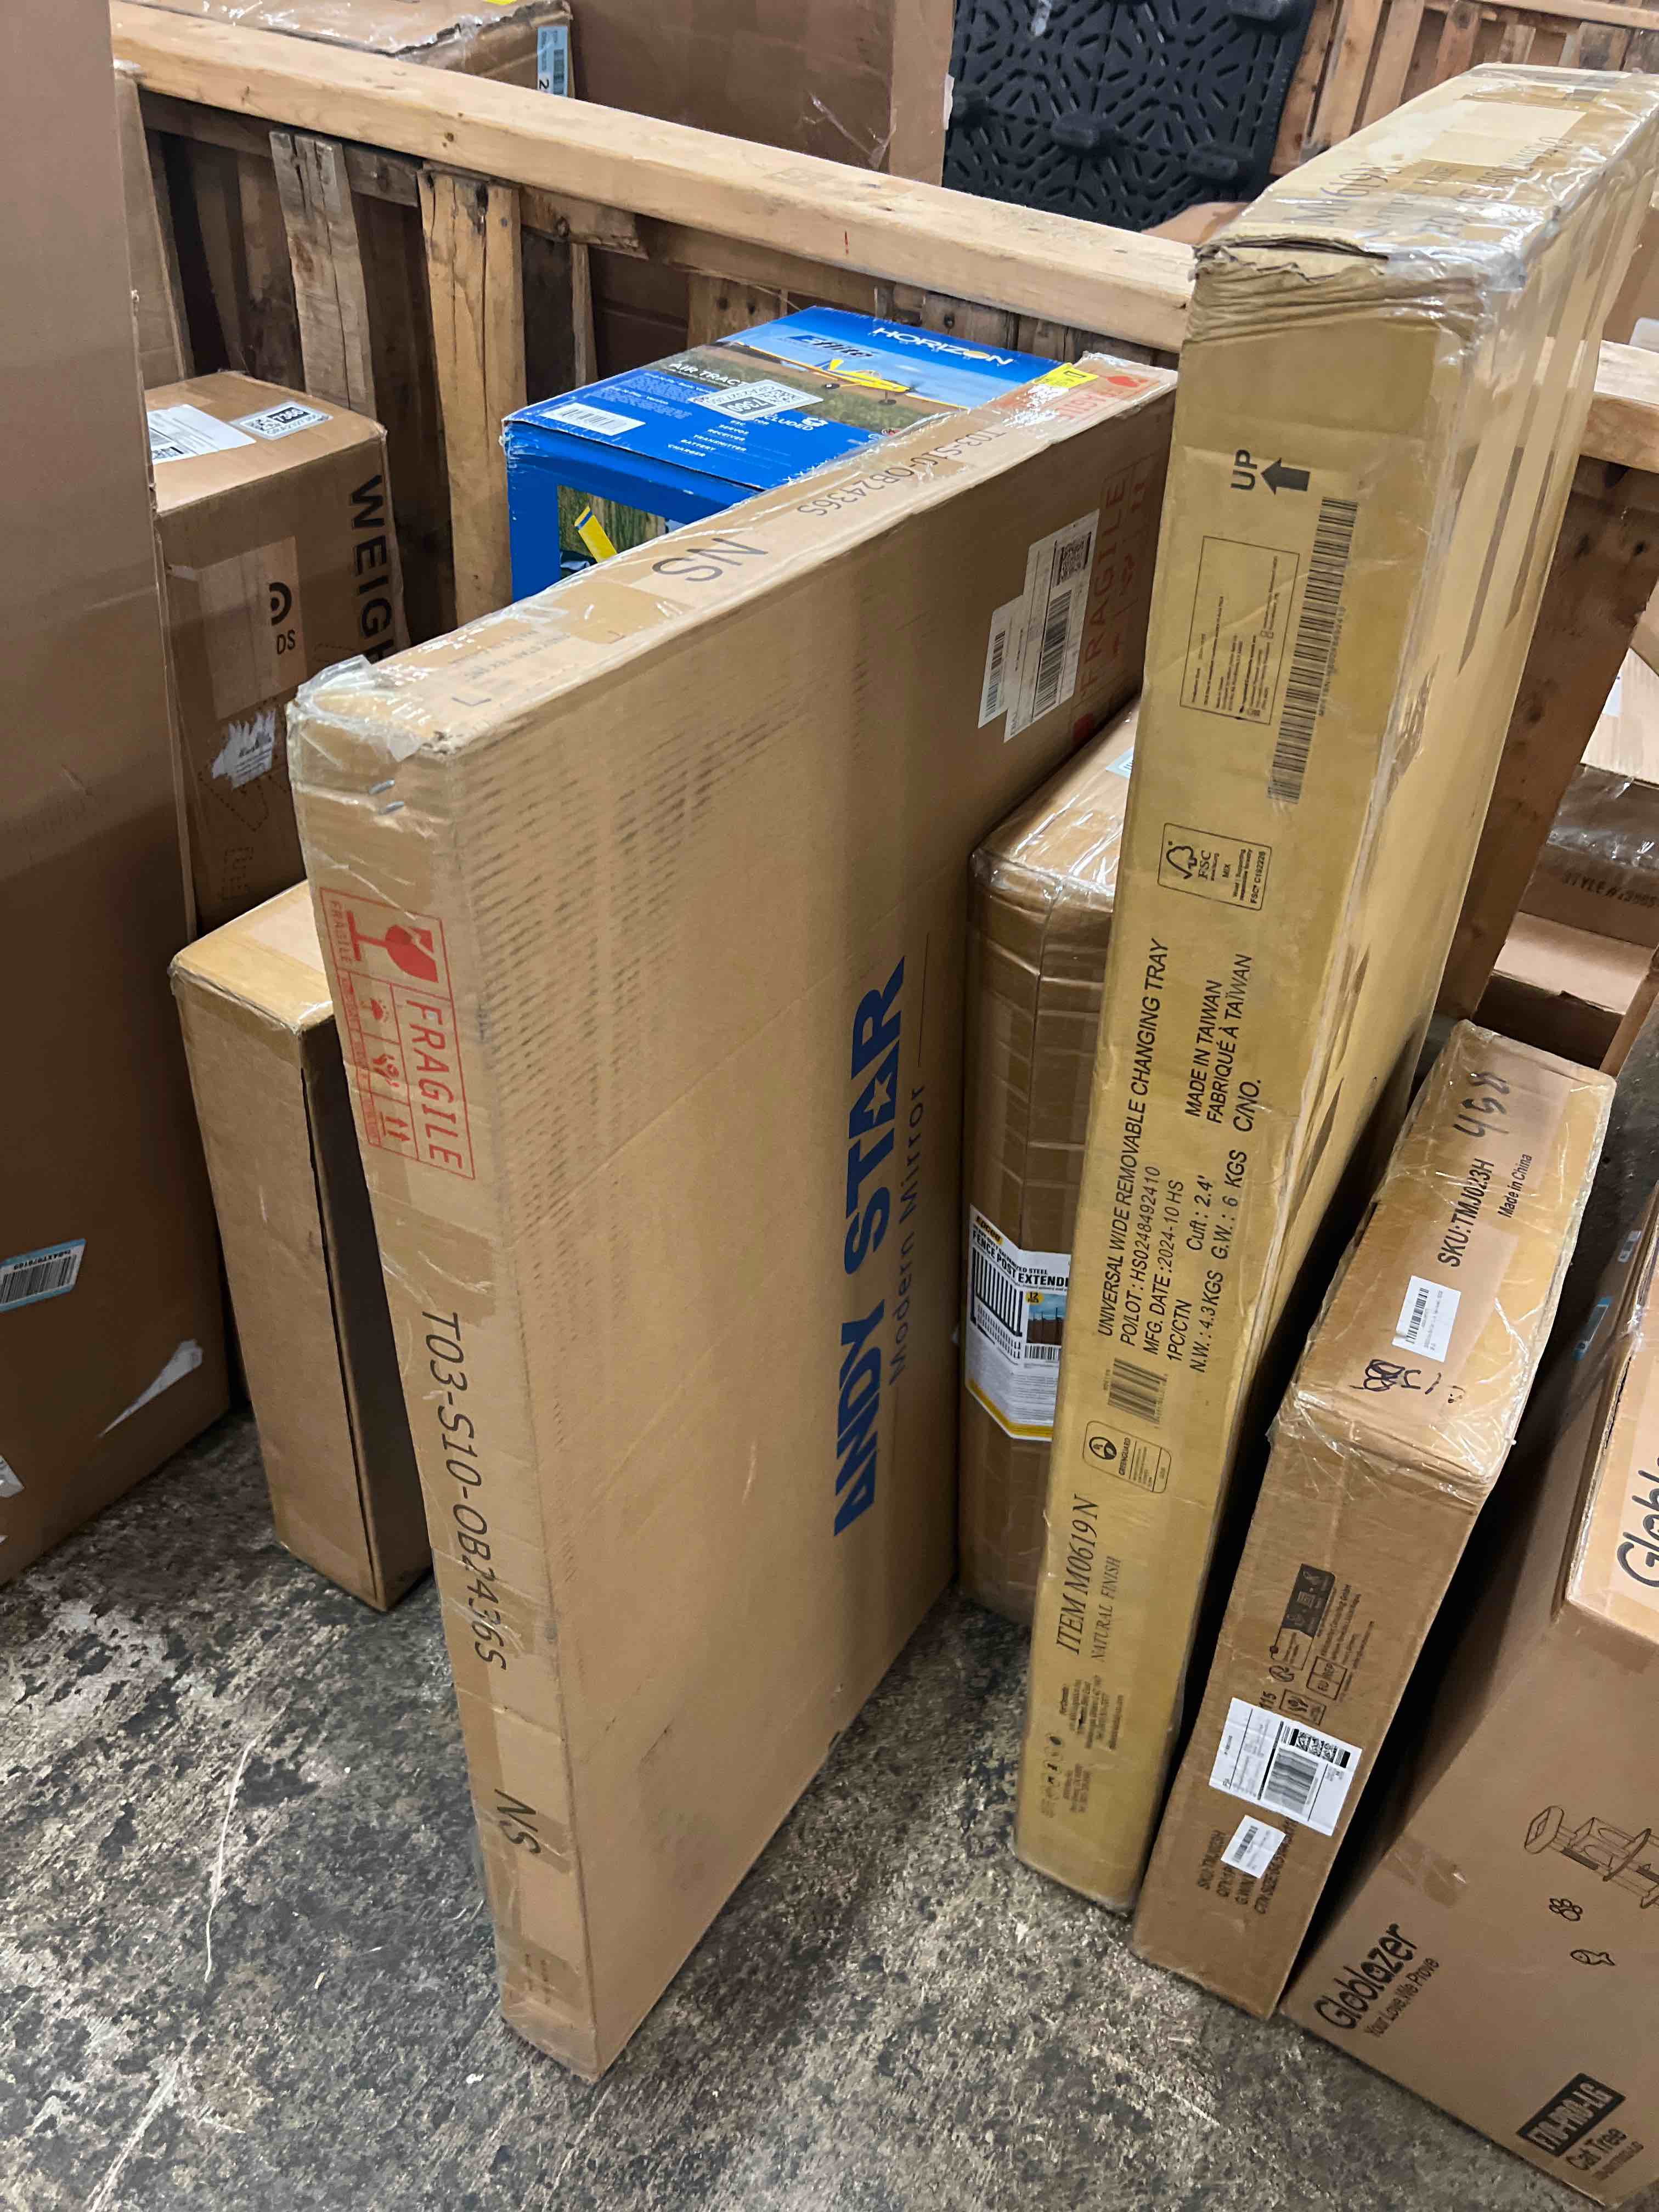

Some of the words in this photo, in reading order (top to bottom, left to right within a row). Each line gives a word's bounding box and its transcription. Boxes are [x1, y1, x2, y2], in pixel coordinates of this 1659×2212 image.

[669, 363, 698, 374] AIR
[870, 326, 1014, 366] HORIZON
[680, 439, 716, 452] BATTERY
[693, 434, 747, 452] TRANSMITTER
[763, 412, 815, 431] CLUDED
[667, 444, 706, 457] CHARGER
[1231, 448, 1259, 492] UP
[1197, 850, 1211, 880] FSC
[1222, 864, 1231, 878] MIX
[330, 900, 351, 962] FRAGILE
[1144, 938, 1168, 990] TRAY
[1195, 980, 1224, 1045] TAIWAN
[1130, 996, 1160, 1096] CHANGING
[1193, 1047, 1210, 1067] IN
[1206, 1040, 1235, 1124] FABRIQUÉ
[1223, 952, 1253, 1020] TAÏWAN
[406, 999, 464, 1169] FRAGILE
[1184, 1069, 1207, 1117] MADE
[1232, 1079, 1262, 1132] C/NO.
[844, 955, 905, 1276] STAR
[900, 1085, 926, 1221] Mirror
[1115, 1098, 1147, 1206] REMOVABLE
[1223, 1149, 1248, 1188] KGS
[1511, 1153, 1533, 1181] China
[1221, 1195, 1239, 1207] 6
[1497, 1192, 1520, 1218] Made
[1507, 1180, 1523, 1192] in
[1108, 1206, 1130, 1251] WIDE
[1437, 1158, 1494, 1268] SKU:TMJ023H
[973, 1229, 995, 1259] FENCE
[996, 1252, 1017, 1279] POST
[1143, 1320, 1163, 1355] MFG.
[1167, 1180, 1185, 1204] HS
[888, 1231, 915, 1386] Modern
[1097, 1255, 1124, 1337] UNIVERSAL
[1168, 1298, 1193, 1362] 1PC/CTN
[833, 1298, 884, 1536] ANDY
[1101, 1555, 1122, 1600] FINISH
[1056, 1593, 1086, 1655] ITEM
[1090, 1604, 1114, 1663] NATURAL
[1313, 1922, 1418, 2030] Globlazer
[1405, 1957, 1440, 1987] Prove
[1565, 2148, 1602, 2171] Cat
[1584, 2128, 1628, 2154] Tree
